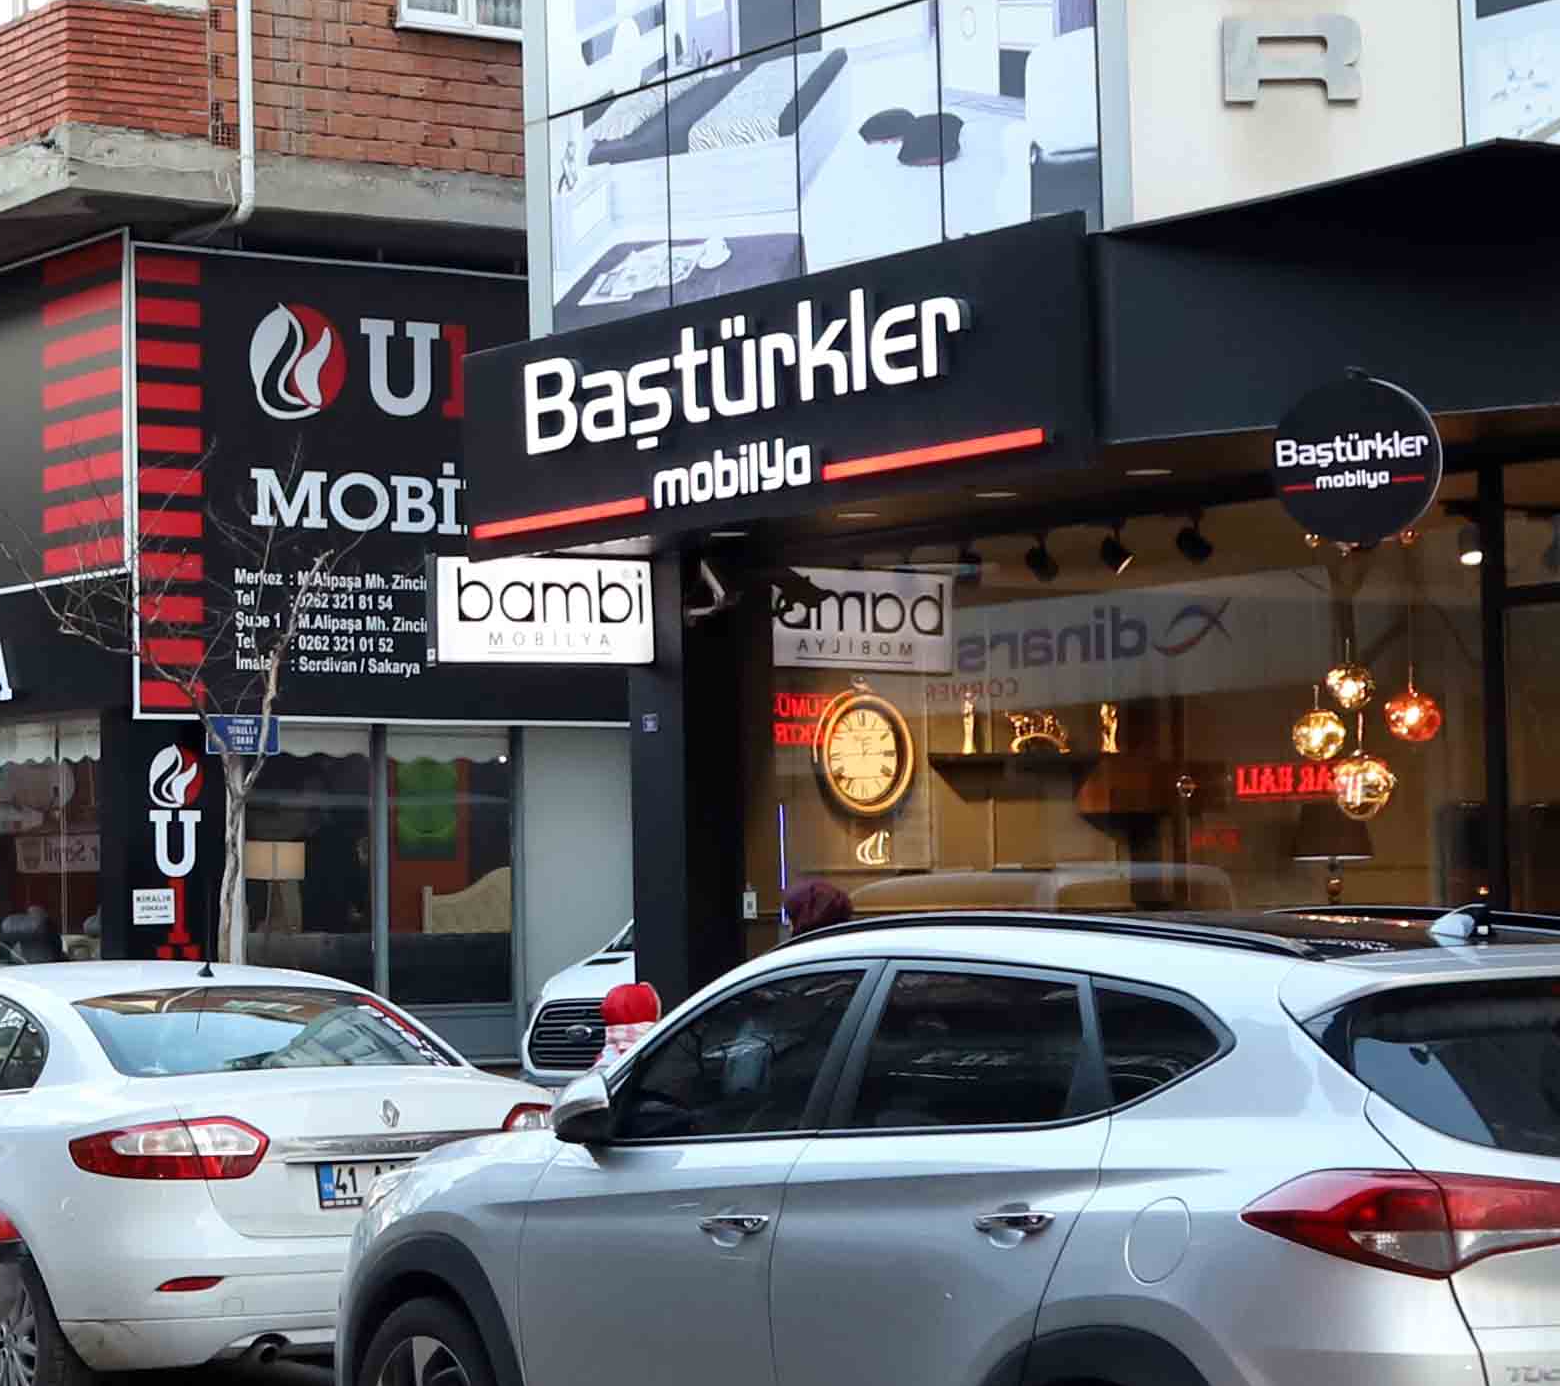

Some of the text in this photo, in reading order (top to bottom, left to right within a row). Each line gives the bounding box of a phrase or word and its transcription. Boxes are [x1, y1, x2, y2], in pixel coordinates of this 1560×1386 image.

[524, 288, 962, 456] Baştürkler
[1275, 430, 1429, 468] Baştürkler
[653, 437, 813, 510] mobilya
[1316, 469, 1390, 489] mobilya
[250, 462, 467, 536] MOBİ
[234, 568, 283, 587] Merkez
[365, 573, 389, 589] Mh.
[235, 590, 254, 606] Tel
[333, 594, 354, 610] 321
[358, 595, 374, 610] 81
[377, 595, 393, 611] 54
[457, 566, 644, 625] bambi
[273, 613, 281, 628] 1
[298, 614, 362, 634] M.Alipaşa
[365, 616, 389, 632] Mh.
[235, 633, 394, 653] Tel 0262 321 01 52
[488, 631, 611, 647] MOBİLYA
[235, 650, 278, 671] İmala
[299, 656, 357, 674] Serdivan
[368, 658, 420, 678] Sakarya
[335, 1165, 358, 1195] 41
